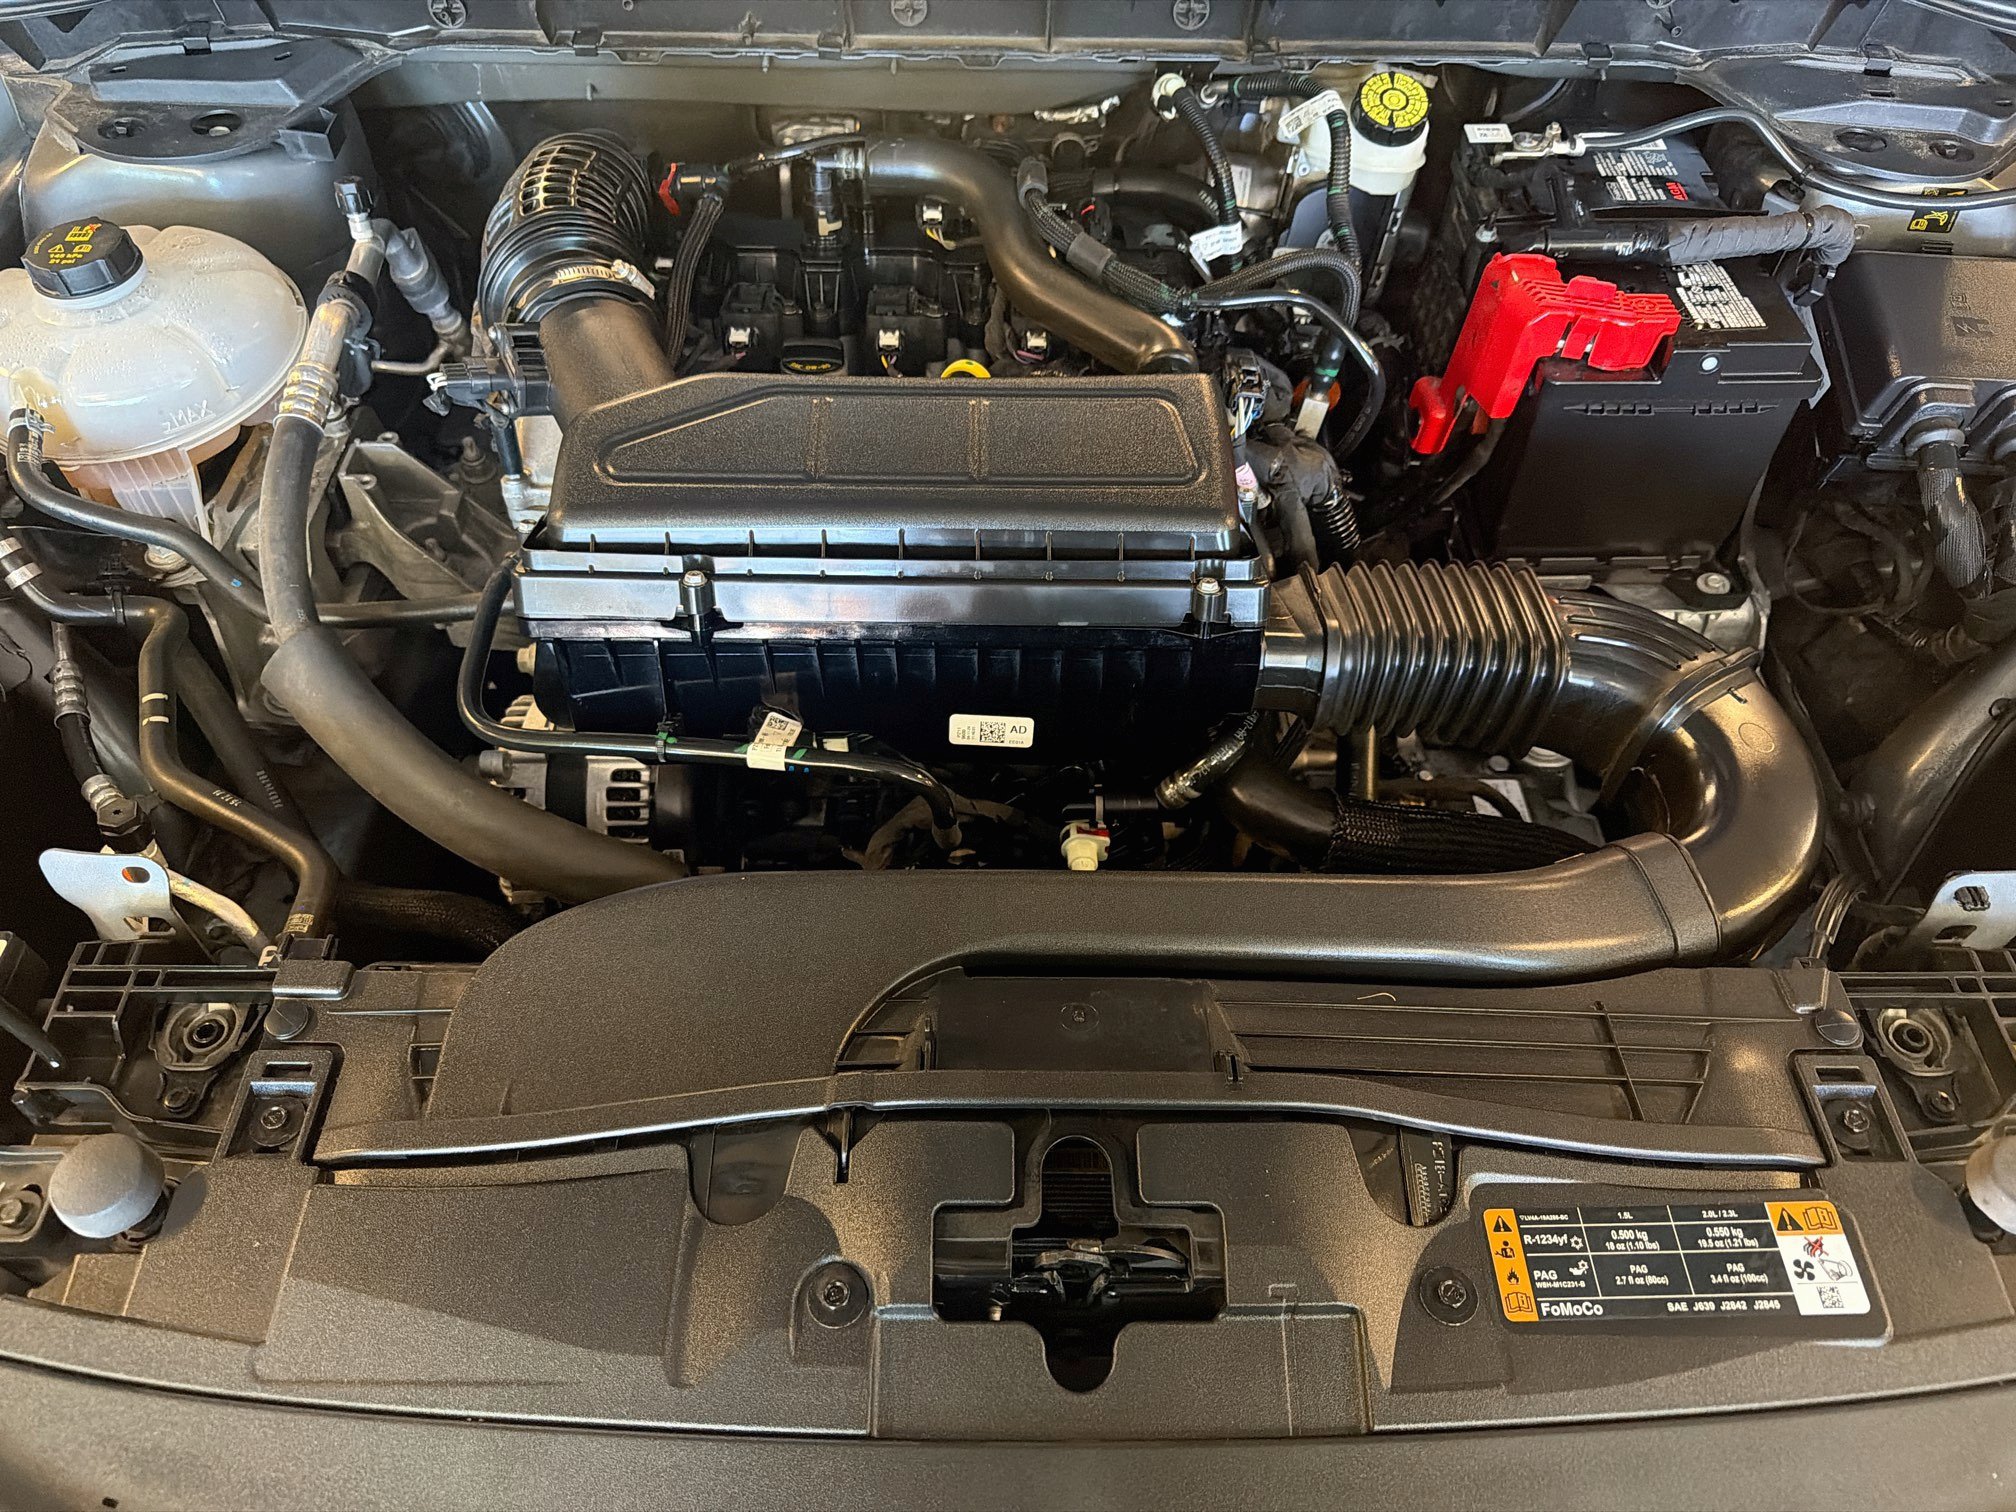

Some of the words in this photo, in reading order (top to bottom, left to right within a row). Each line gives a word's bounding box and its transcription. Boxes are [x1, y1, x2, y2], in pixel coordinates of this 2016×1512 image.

[1010, 725, 1027, 734] AD
[1617, 1211, 1634, 1219] 1.5L
[1702, 1210, 1718, 1218] 2.0L
[1611, 1229, 1635, 1240] 0.500
[1636, 1229, 1649, 1242] kg
[1706, 1227, 1730, 1238] 0.550
[1731, 1227, 1744, 1239] kg
[1523, 1234, 1568, 1246] R-1234yf
[1697, 1238, 1714, 1248] 19.5
[1715, 1239, 1725, 1247] oz
[1725, 1238, 1743, 1249] (1.21
[1743, 1237, 1759, 1248] lbs)
[1605, 1242, 1616, 1250] 18
[1626, 1241, 1645, 1251] (1.10
[1645, 1241, 1660, 1251] lbs)
[1630, 1264, 1648, 1274] PAG
[1726, 1263, 1745, 1273] PAG
[1533, 1270, 1558, 1281] PAG
[1615, 1276, 1627, 1285] 2.7
[1627, 1275, 1634, 1285] fl
[1635, 1276, 1645, 1285] oz
[1710, 1274, 1722, 1284] 3.4
[1723, 1274, 1730, 1283] fl
[1730, 1275, 1740, 1283] oz
[1740, 1273, 1768, 1285] (100cc)
[1540, 1301, 1604, 1316] FoMoCo
[1666, 1302, 1689, 1312] SAE
